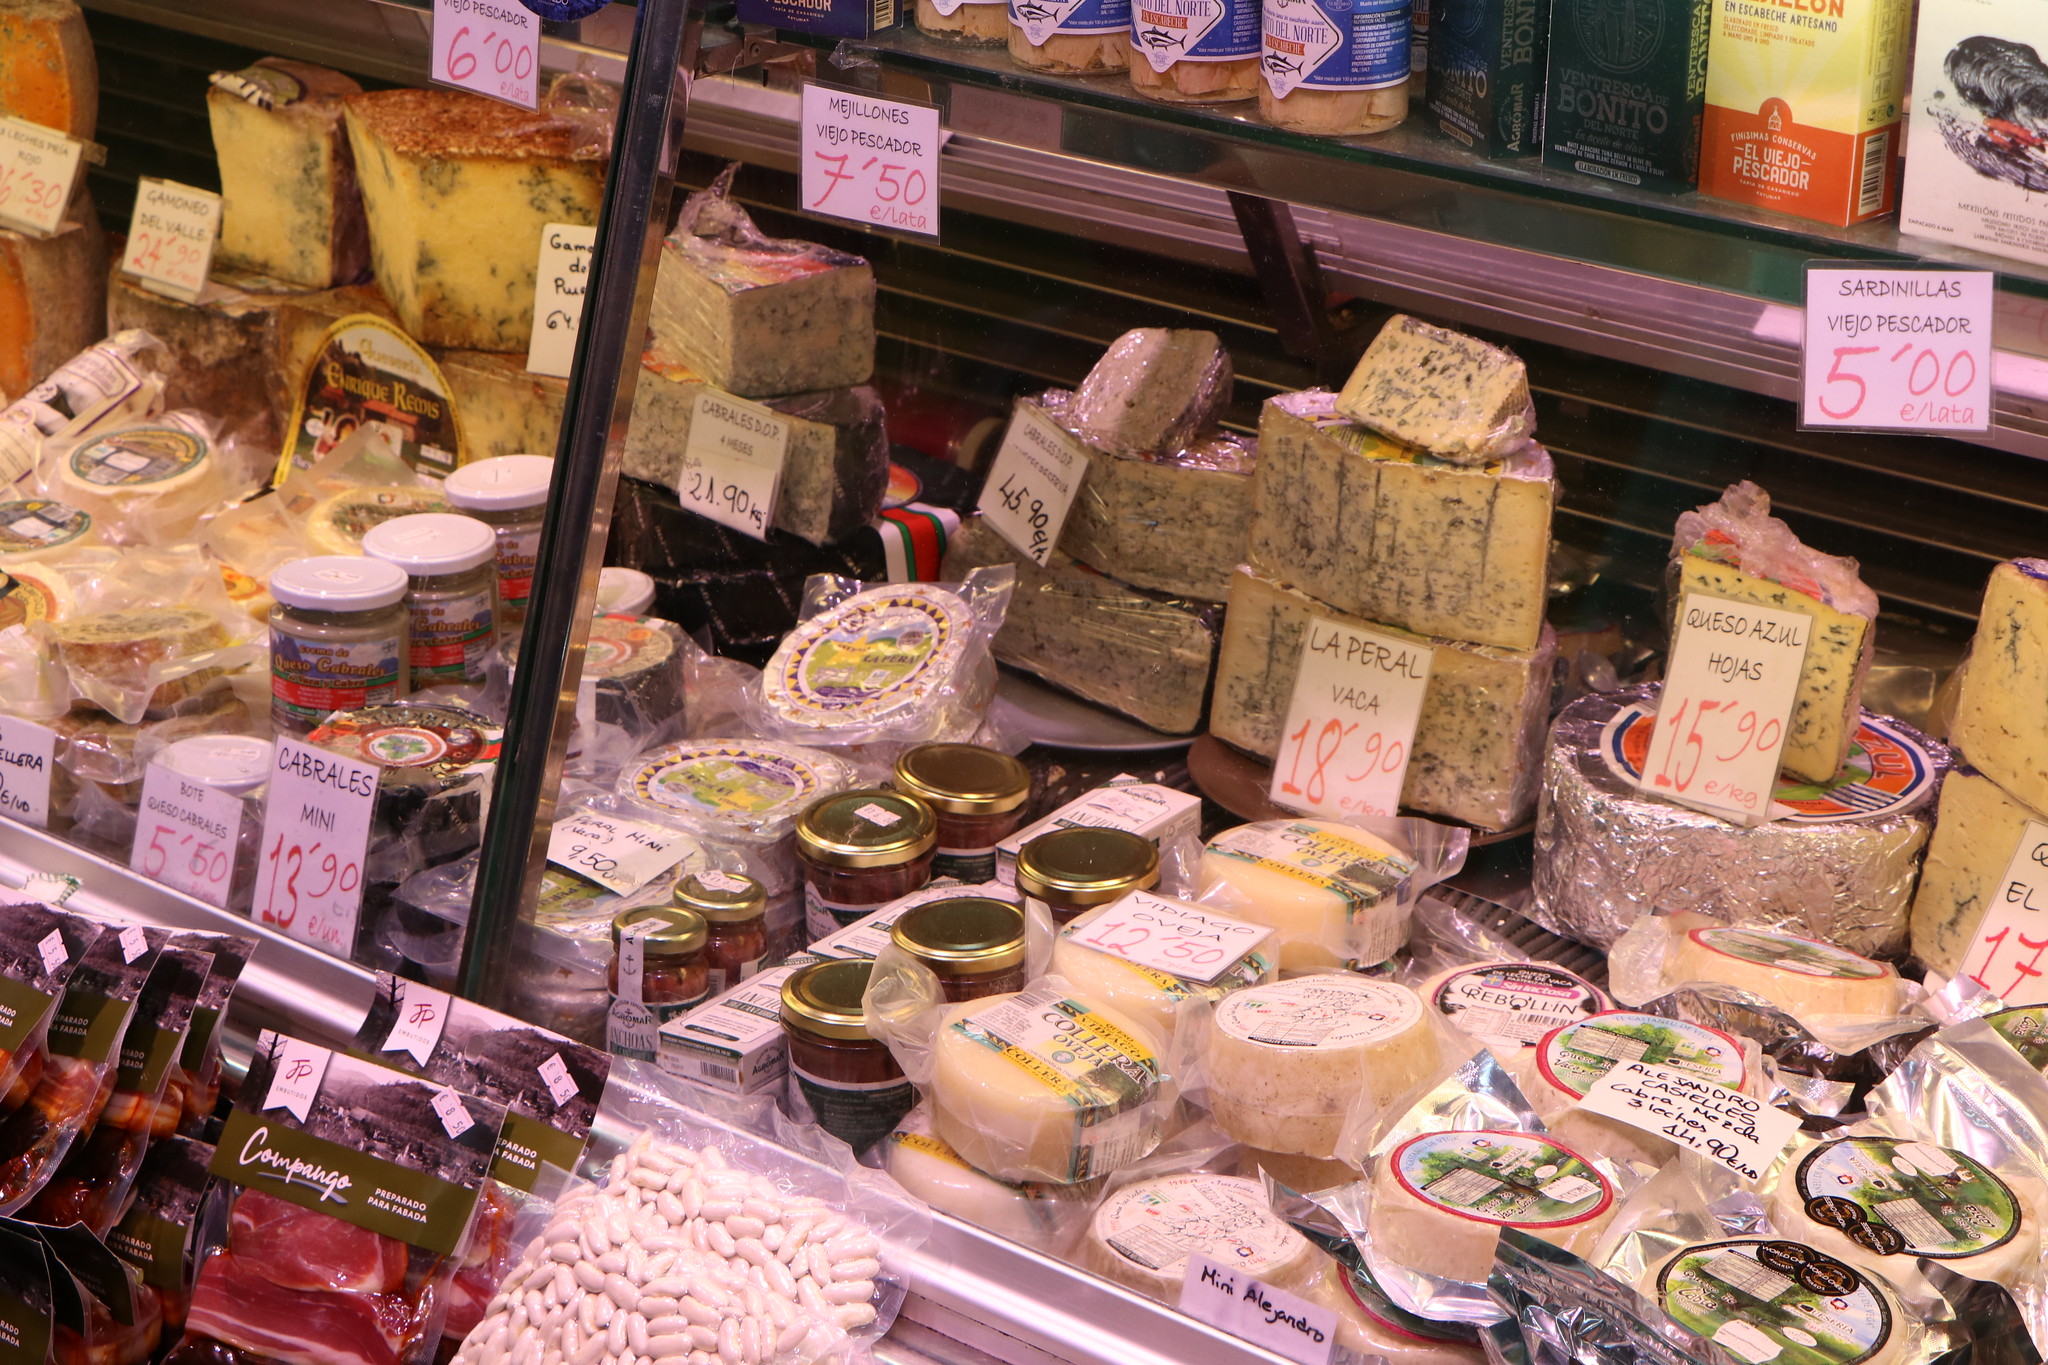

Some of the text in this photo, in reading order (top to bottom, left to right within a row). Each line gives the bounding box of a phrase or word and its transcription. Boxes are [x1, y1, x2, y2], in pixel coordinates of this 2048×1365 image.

[473, 3, 529, 29] PESCADOR
[1150, 12, 1185, 28] ESCABECHE
[1155, 0, 1211, 17] DEL NORTE
[1725, 3, 1838, 33] EN ESCABECHE ARTESANO
[1275, 21, 1329, 45] DEL NORTE
[1723, 15, 1779, 32] ELABORADO FRESCO
[1272, 38, 1302, 55] ESCABECHE
[1728, 31, 1770, 46] MANO UNO UNO
[1760, 31, 1815, 48] LIMPIADO ENLATADO
[1687, 4, 1702, 102] VENTRESCA
[1559, 67, 1652, 100] VENTRESCA
[828, 97, 909, 125] MEJILLONES
[1507, 83, 1524, 152] AGROMAR
[1557, 83, 1668, 134] BONITO
[7, 130, 44, 150] LECHES
[816, 124, 923, 157] VIEJO PESCADOR
[1583, 118, 1640, 140] DEL NORTE
[18, 150, 42, 166] ROJO
[1744, 143, 1801, 171] EL VIEJO
[1772, 135, 1817, 161] CONSERVAS
[1611, 169, 1619, 179] EN
[1620, 171, 1638, 183] FRESCO
[1733, 156, 1810, 191] PESCADOR
[1756, 190, 1782, 201] ASTURIAS
[1757, 182, 1800, 197] DE CASARIEGO
[146, 189, 209, 217] GAMONEO
[140, 213, 205, 242] DEL VALLE
[1908, 218, 1936, 229] EMPACADO
[1838, 279, 1962, 298] SARDINILLAS
[1828, 314, 1973, 338] VIEJO PESCADOR
[701, 398, 753, 432] CABRALES
[727, 439, 754, 457] MESES
[1023, 423, 1058, 461] CABRALES
[688, 472, 750, 514] 21.90
[414, 617, 481, 633] Cabrales
[1686, 607, 1803, 648] QUESO AZUL
[299, 645, 350, 658] Crema de
[1310, 626, 1424, 680] LA PERAL
[274, 653, 386, 677] Queso Cabrales
[1708, 652, 1763, 683] HOJAS
[1331, 684, 1380, 716] VACA
[277, 746, 374, 797] CABRALES
[180, 781, 205, 802] BOTE
[1120, 786, 1166, 806] AGROMAR
[147, 796, 228, 840] QUESO CABRALES
[300, 802, 336, 832] MINI
[2006, 880, 2040, 913] EL
[1134, 895, 1255, 935] VIDIAGO
[1133, 912, 1221, 943] OVEJA
[1506, 971, 1532, 981] LECHE
[1549, 978, 1573, 987] VACA
[1506, 976, 1554, 988] PASTERIZADA
[1518, 969, 1551, 979] QUESO
[1501, 981, 1574, 998] Sin lactosa
[611, 1006, 652, 1025] AGROMAR
[59, 1024, 88, 1036] FABADA
[397, 1028, 431, 1046] EMBUTIDOS
[1080, 1016, 1142, 1060] VIDIAGO
[1105, 1022, 1135, 1043] QUESO
[1679, 1024, 1693, 1032] DE
[1041, 1011, 1147, 1084] COLLERA
[1052, 1033, 1102, 1068] OVEJA
[1559, 1050, 1598, 1066] Queso
[752, 1052, 785, 1075] AGROMAR
[275, 1086, 308, 1100] EMBUTIDOS
[1626, 1063, 1761, 1113] ALEJANDRO
[1626, 1098, 1708, 1134] 3 leches
[238, 1126, 353, 1201] Compango
[500, 1149, 536, 1170] FABADA
[367, 1195, 428, 1224] PARA FABADA
[374, 1187, 427, 1212] PREPARADO
[1762, 1245, 1790, 1259] WORLD
[1770, 1258, 1795, 1271] AWARDS
[1683, 1268, 1720, 1294] Queso
[1805, 1275, 1826, 1291] AWARDS
[1806, 1262, 1851, 1295] WORLD CHEESE
[1200, 1265, 1325, 1344] Mini Alejandro
